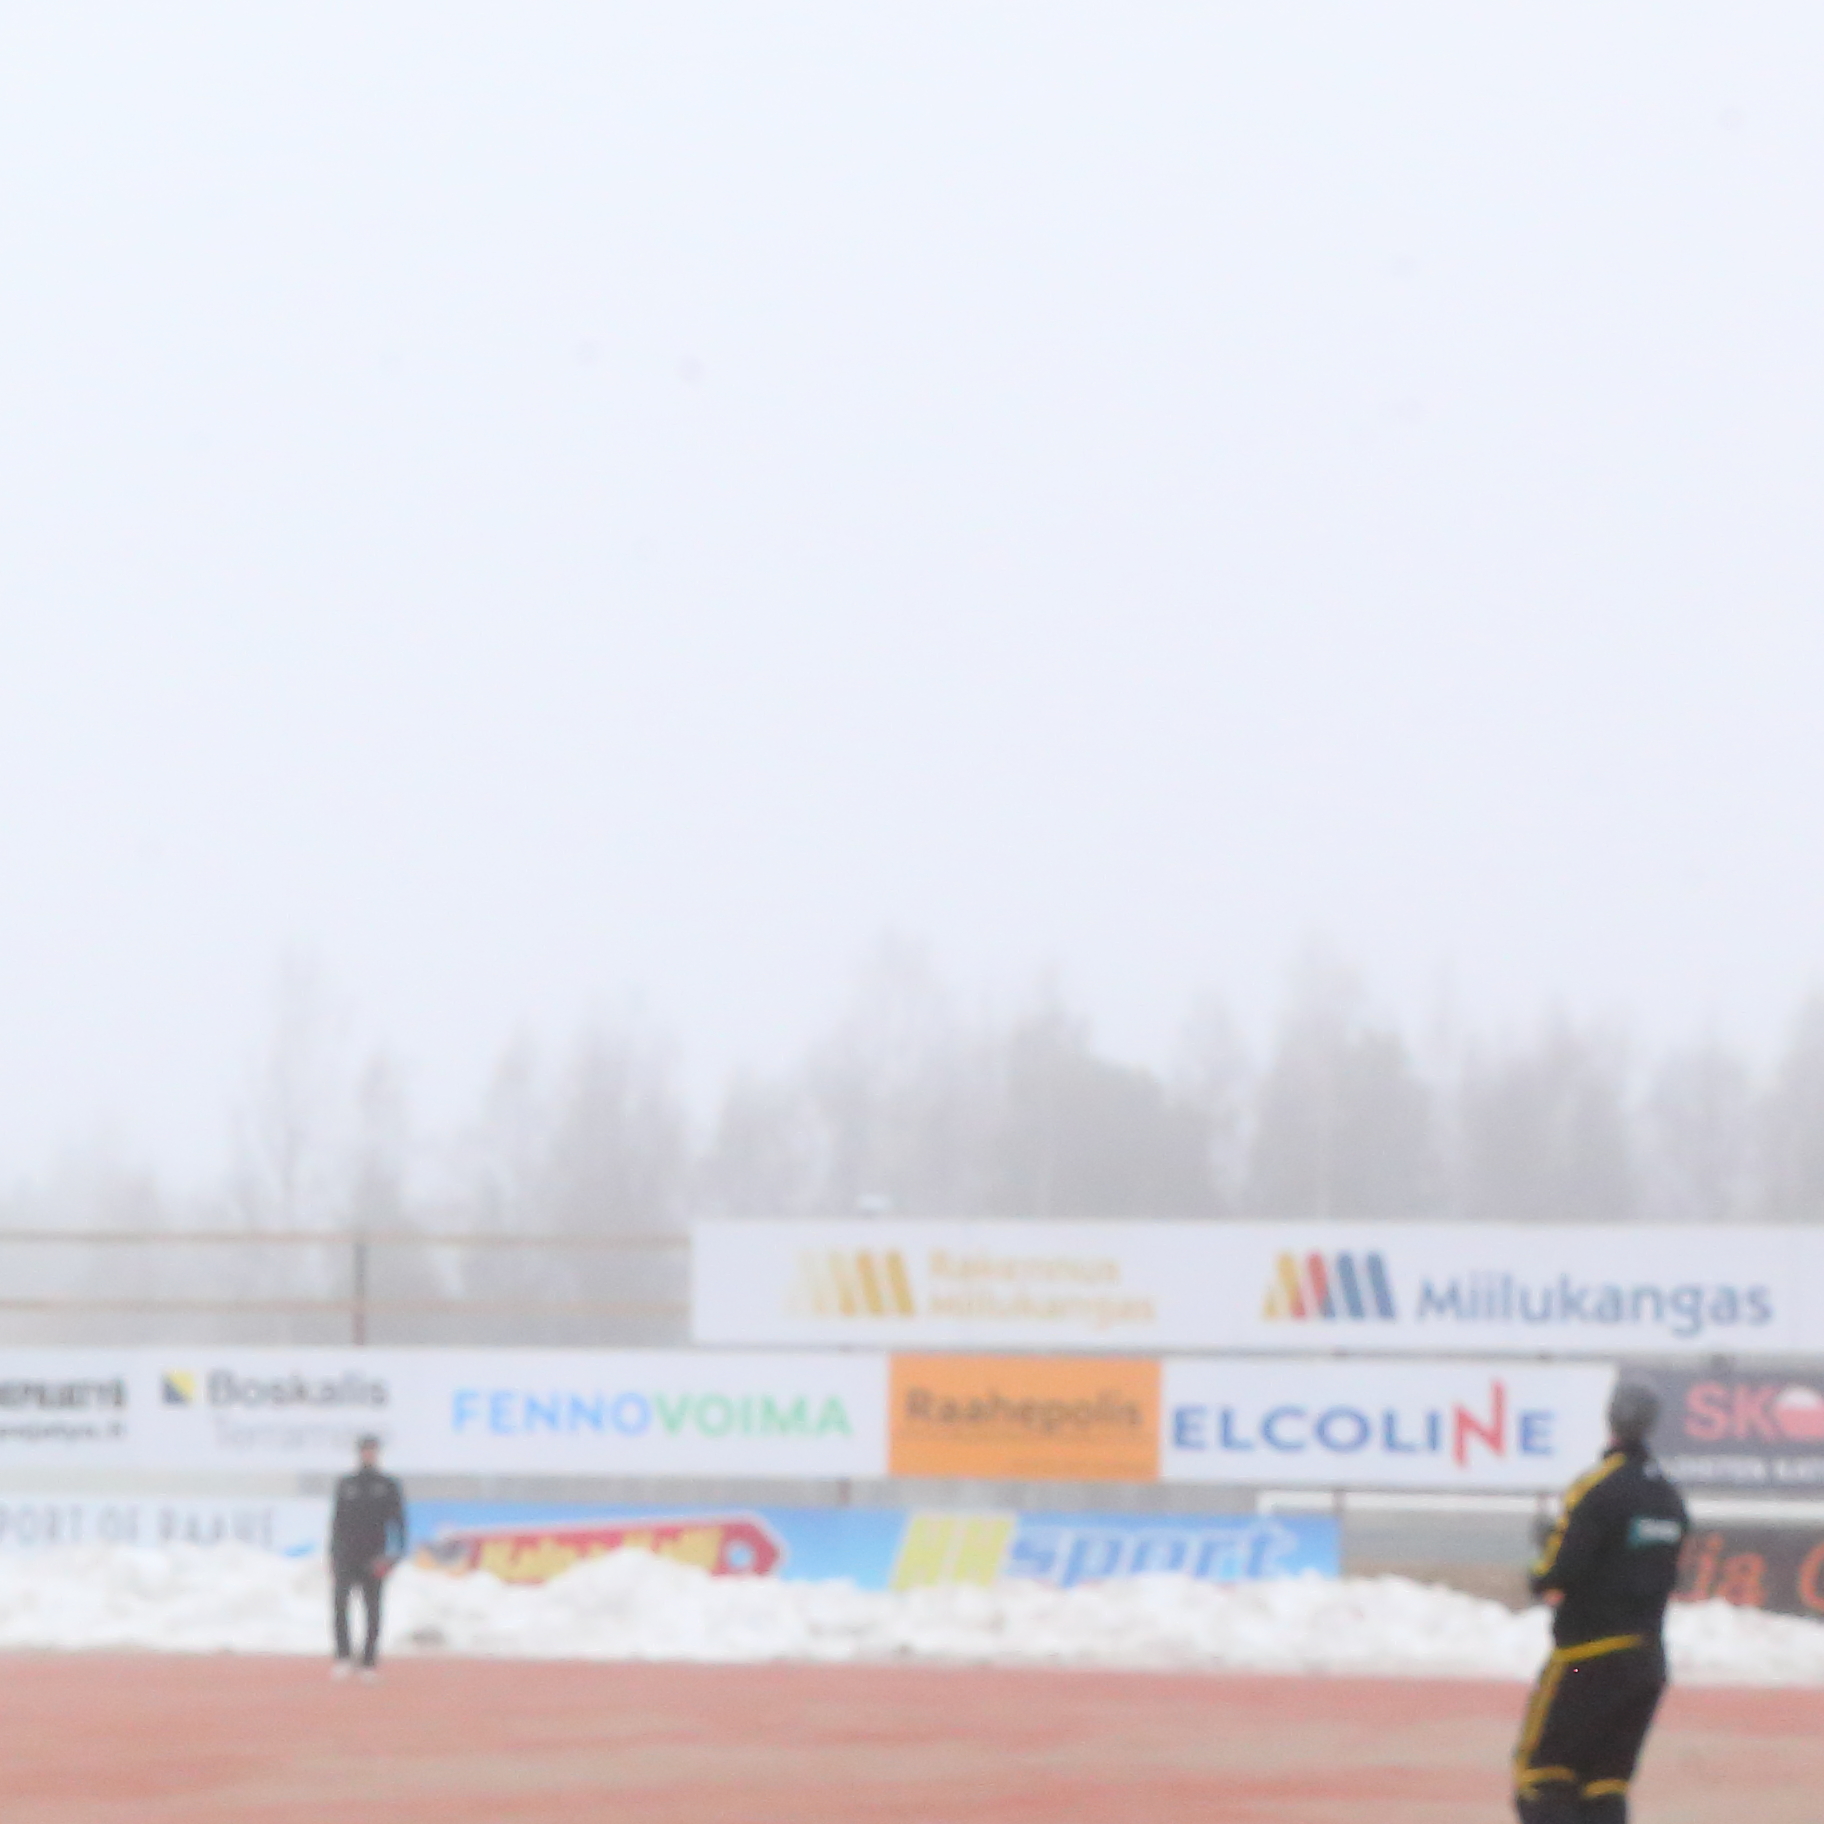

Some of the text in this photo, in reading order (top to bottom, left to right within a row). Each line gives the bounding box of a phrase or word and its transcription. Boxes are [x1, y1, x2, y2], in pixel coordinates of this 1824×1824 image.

[1417, 1271, 1774, 1338] Miilukangas
[206, 1369, 389, 1408] Boskalis
[904, 1387, 1143, 1432] Raahepolis
[452, 1389, 852, 1438] FENNOVOIMA
[1171, 1379, 1555, 1468] ELCOLINE
